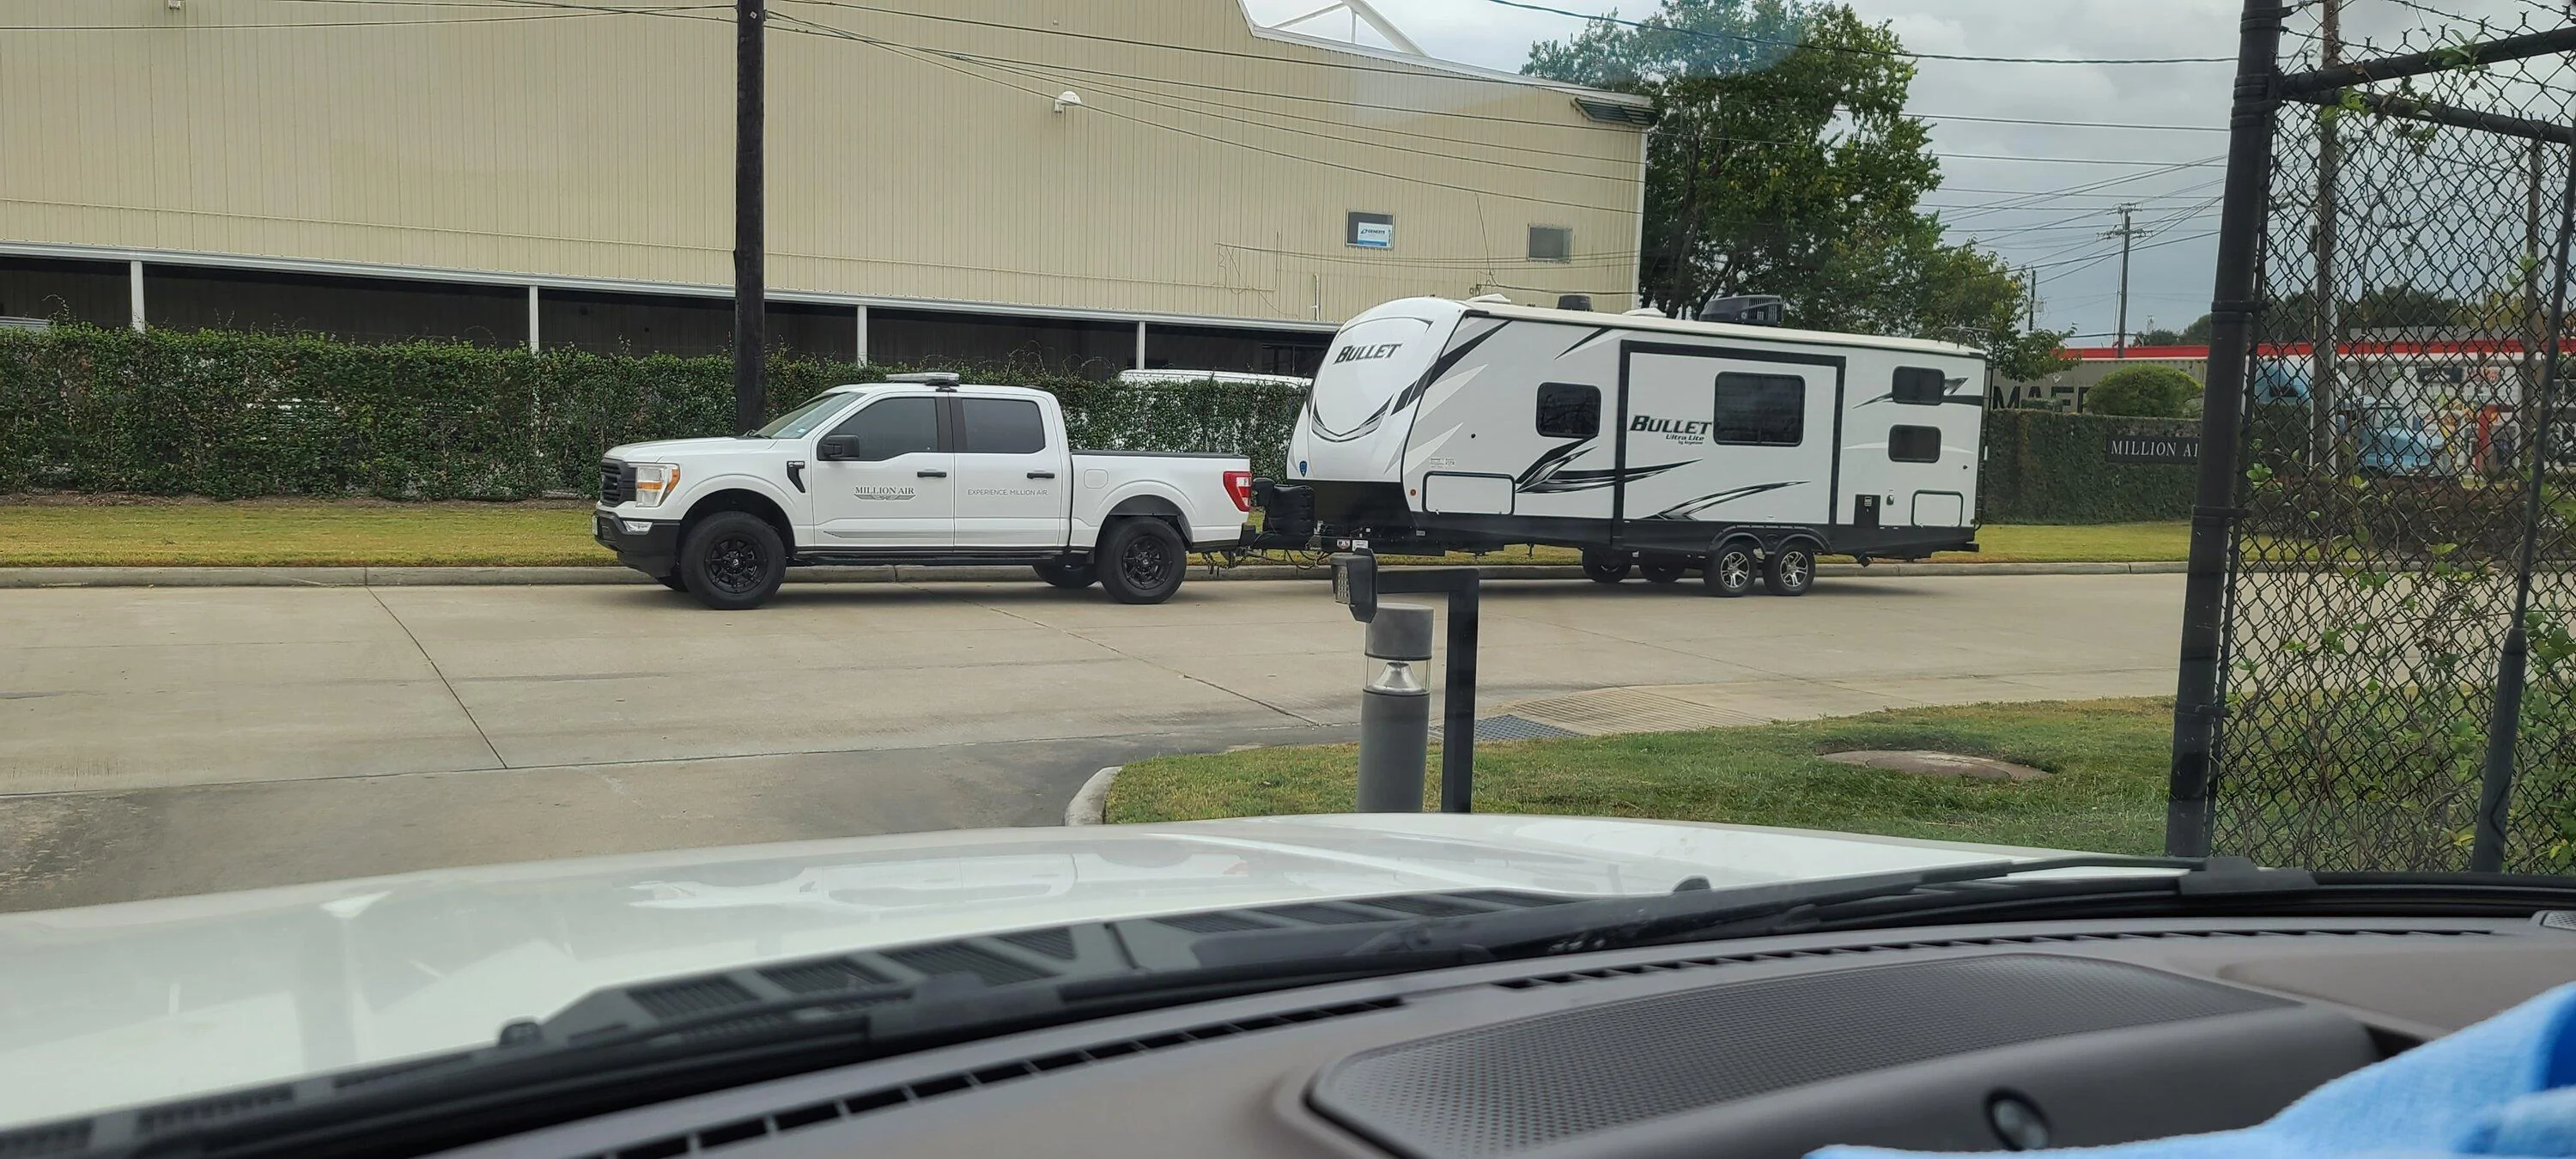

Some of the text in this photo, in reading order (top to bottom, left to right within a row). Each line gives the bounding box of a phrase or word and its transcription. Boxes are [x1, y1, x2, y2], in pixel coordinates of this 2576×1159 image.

[1333, 343, 1403, 365] BULLET
[1629, 415, 1712, 434] BULLET
[2111, 440, 2198, 458] MILLION AI
[855, 486, 896, 495] MILLION
